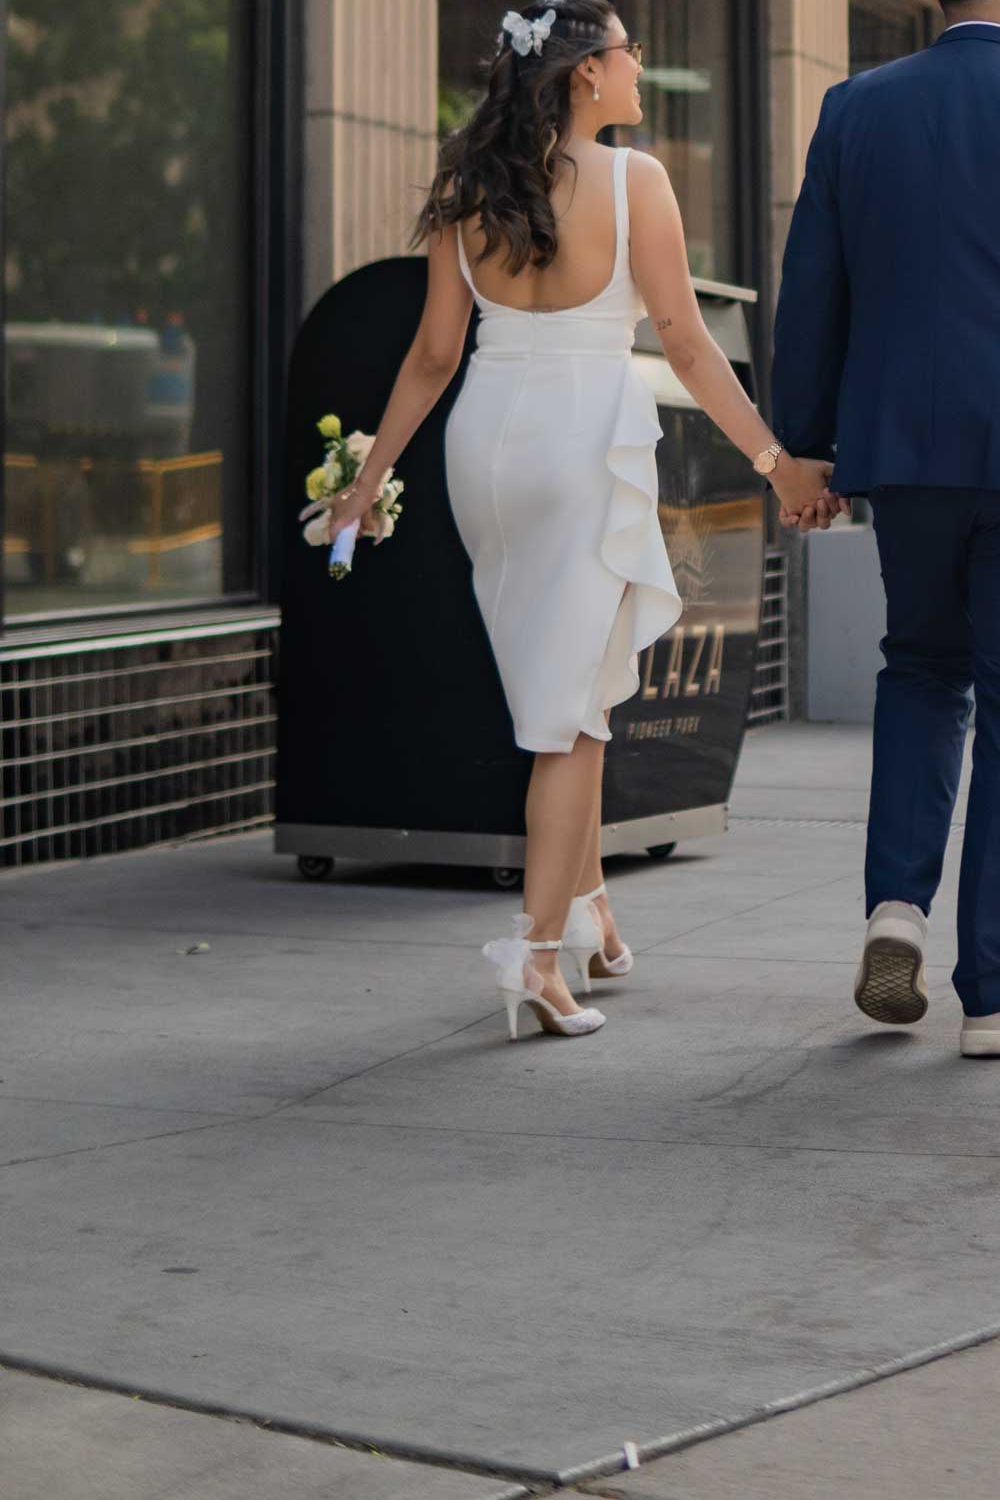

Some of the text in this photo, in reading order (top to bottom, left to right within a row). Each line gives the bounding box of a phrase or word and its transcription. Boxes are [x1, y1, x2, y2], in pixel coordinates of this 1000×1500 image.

[637, 625, 725, 700] LAZA
[627, 715, 702, 741] PIONEER PARK
